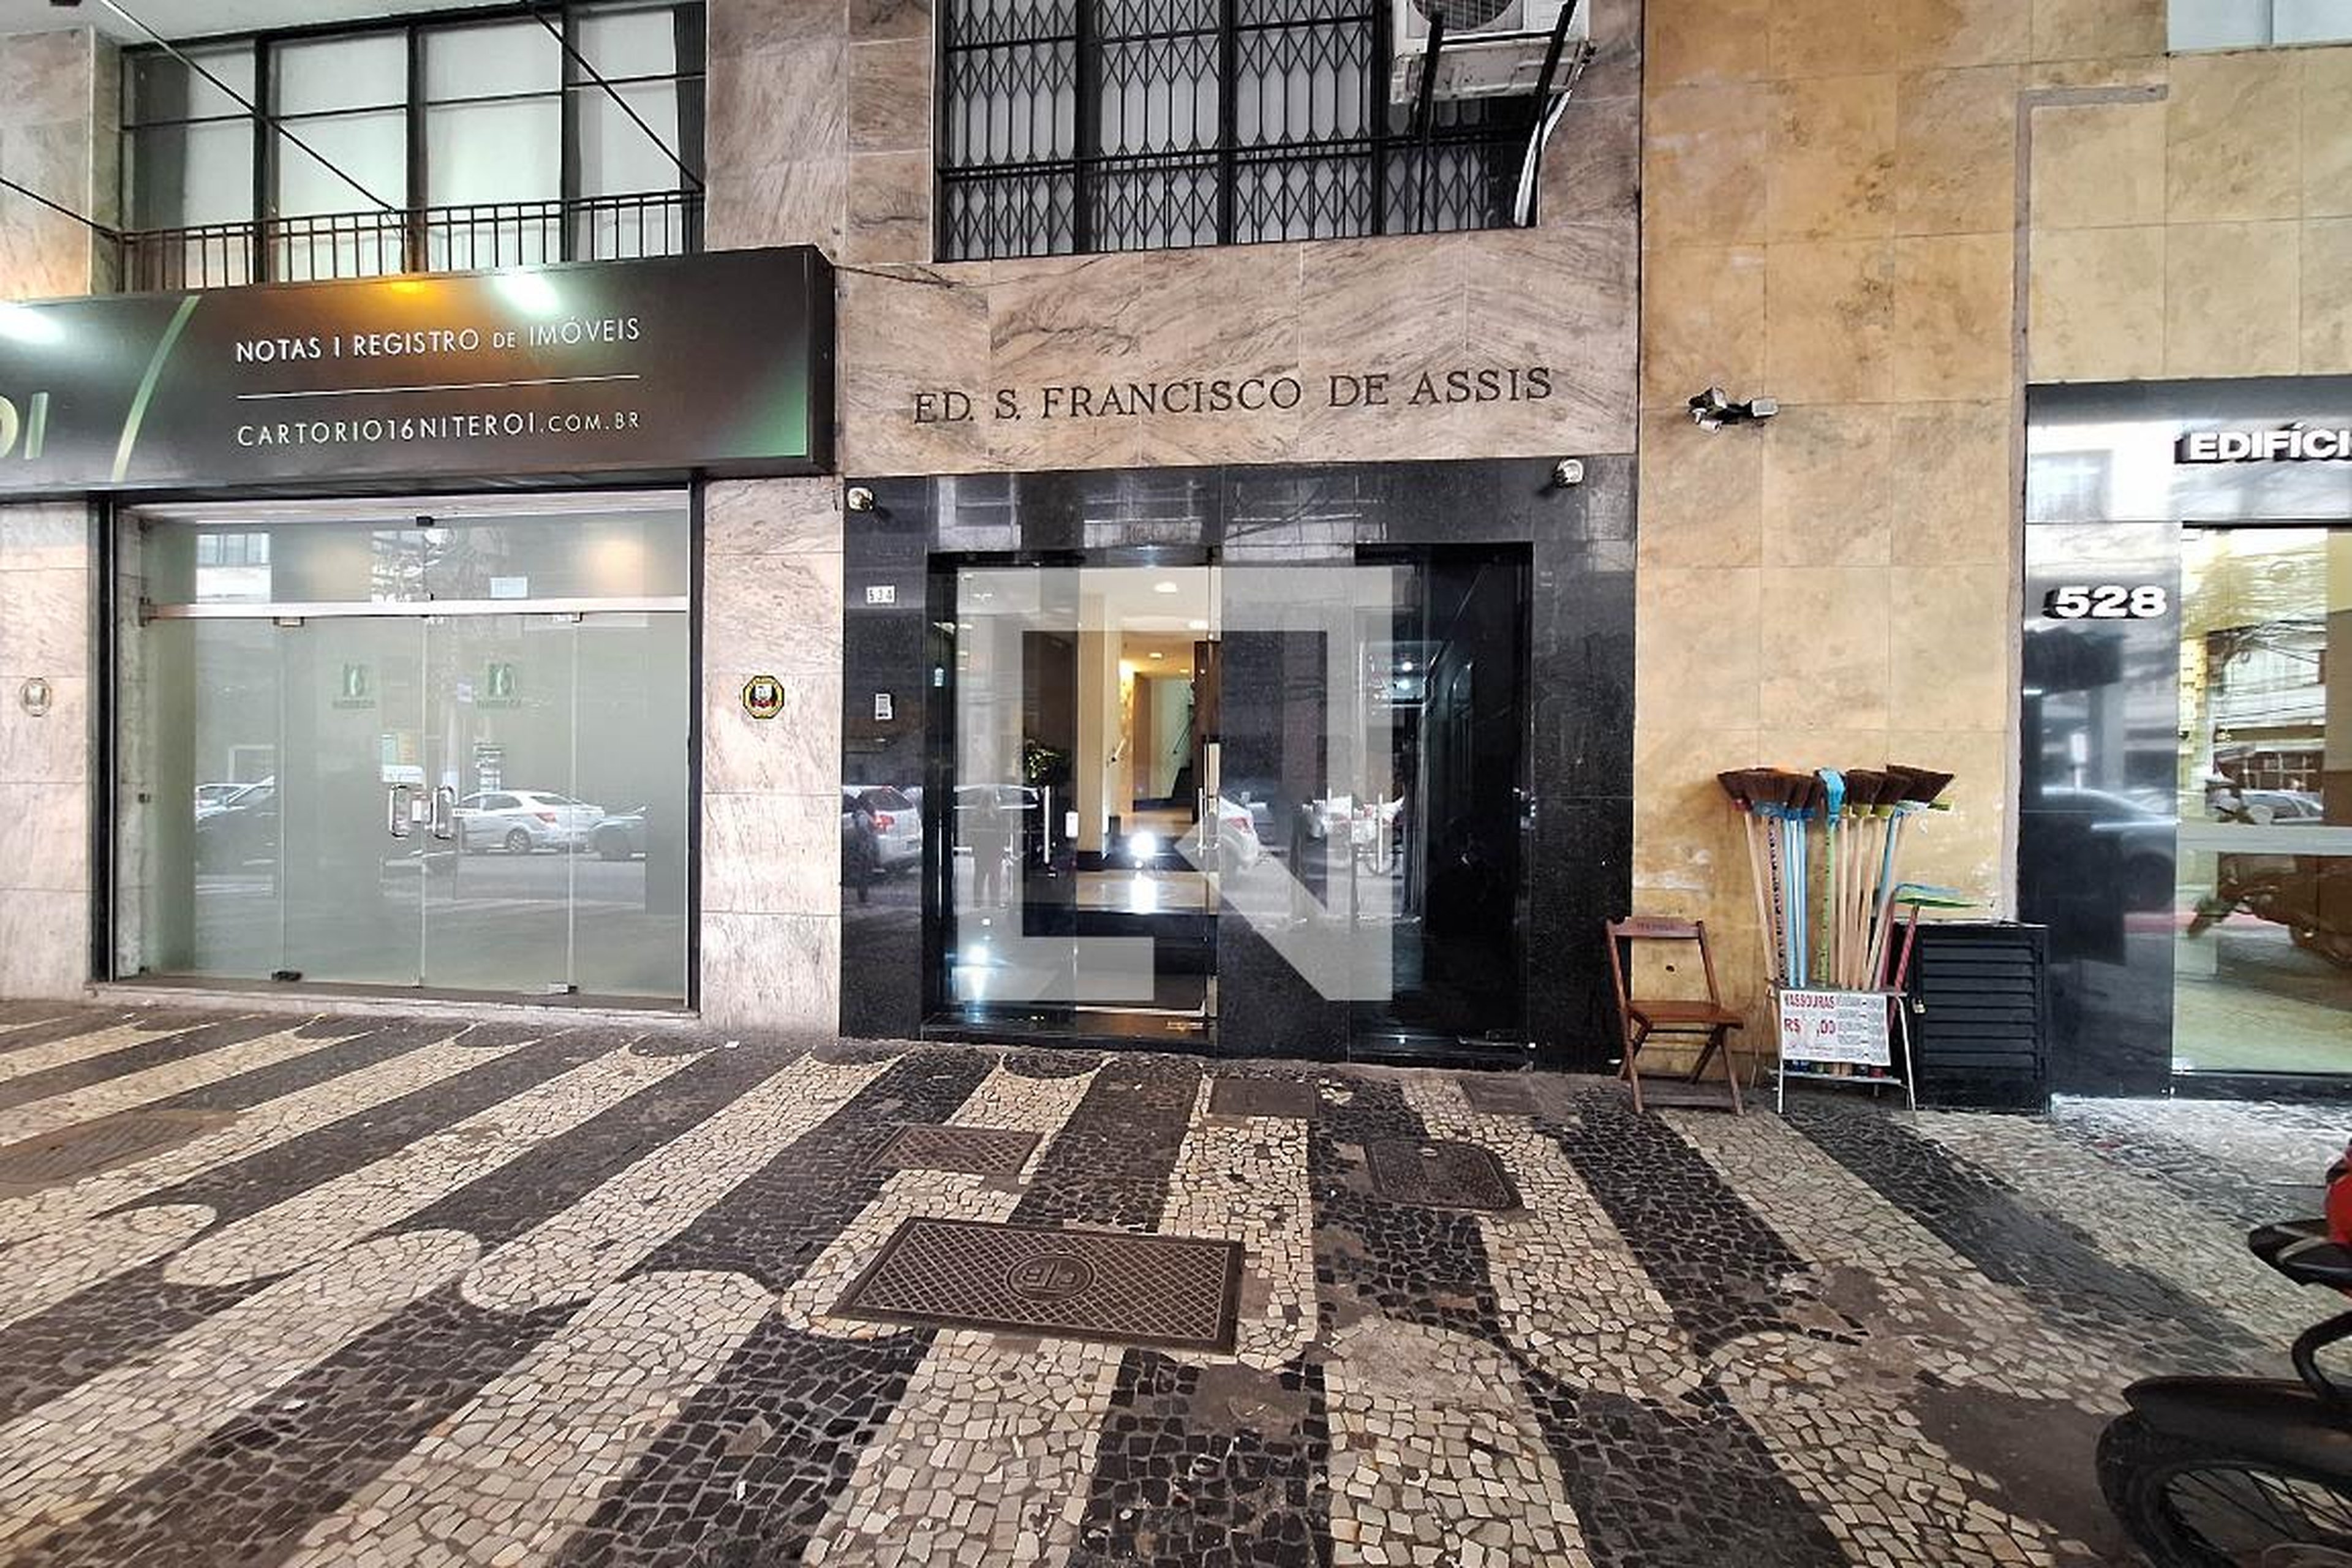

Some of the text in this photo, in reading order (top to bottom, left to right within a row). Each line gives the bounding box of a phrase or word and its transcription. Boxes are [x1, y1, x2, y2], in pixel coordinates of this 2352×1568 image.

[236, 337, 322, 363] NOTAS
[353, 328, 479, 356] REGISTRO
[492, 331, 516, 349] DE
[529, 317, 641, 347] IMÓVEIS
[914, 367, 1553, 424] ED. S. FRANCISCO DE ASSIS
[237, 411, 641, 447] CARTORIO16NITEROI.COM.BR
[2054, 585, 2167, 619] 528
